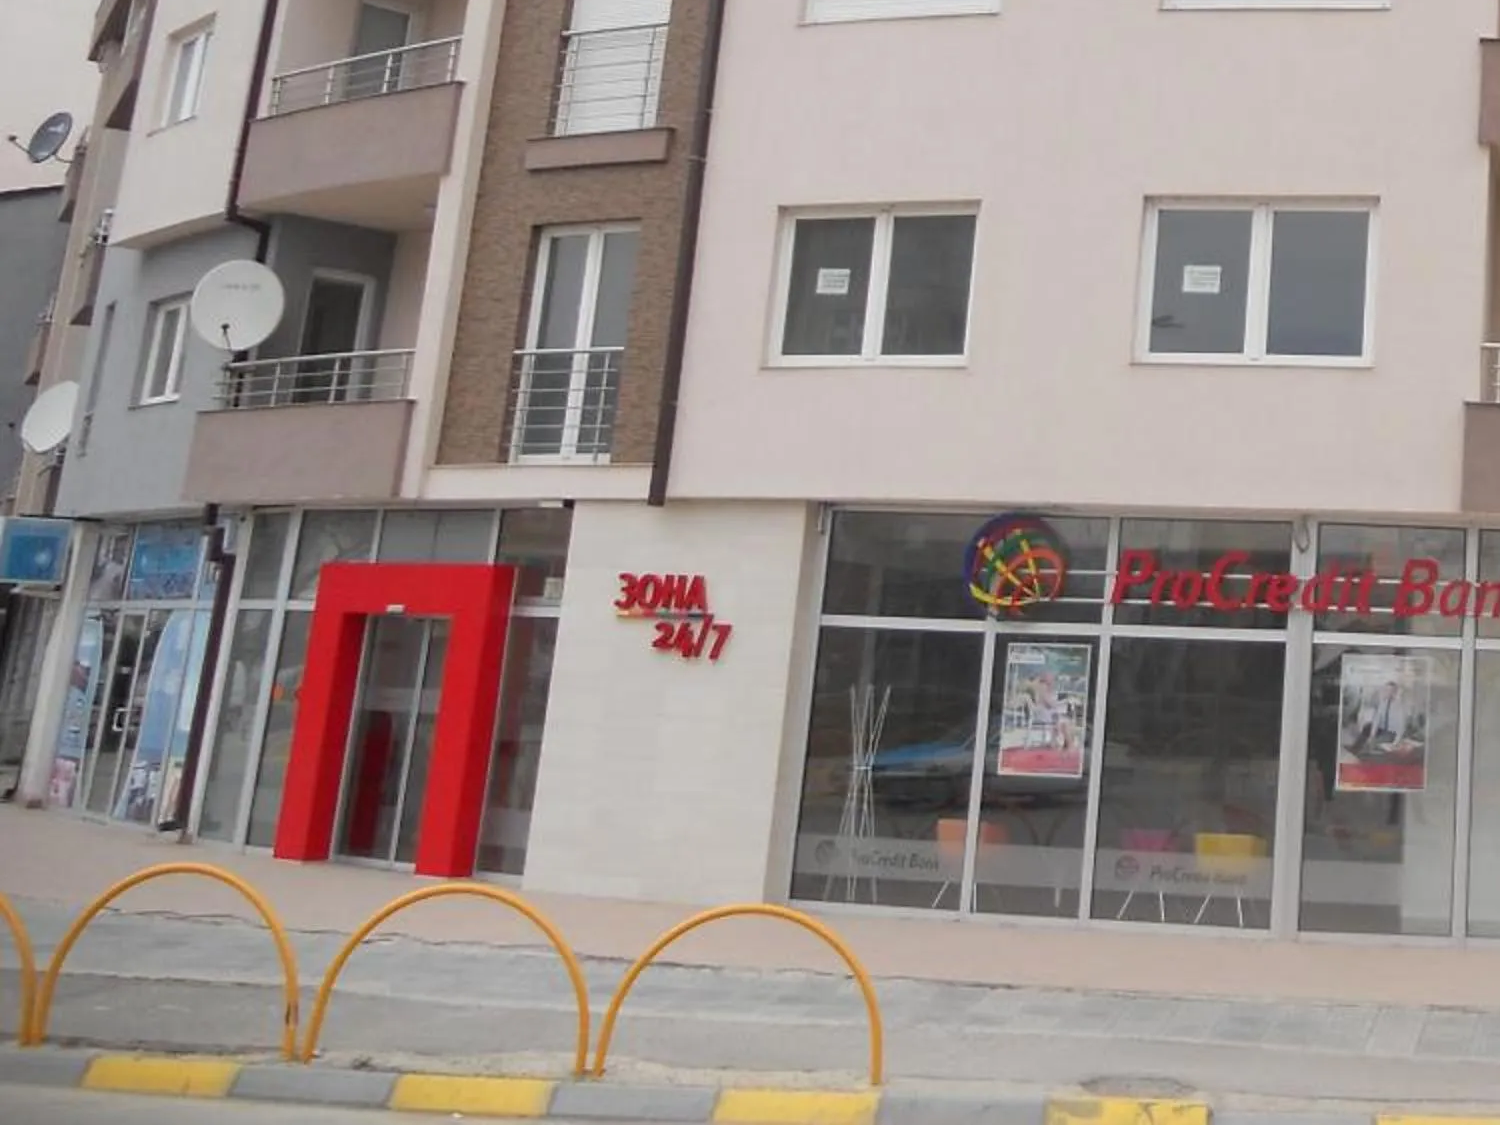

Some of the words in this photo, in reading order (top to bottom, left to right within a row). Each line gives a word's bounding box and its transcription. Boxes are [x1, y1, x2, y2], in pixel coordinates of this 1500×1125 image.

[613, 572, 707, 610] ЗОНА
[1110, 549, 1376, 617] ProCredit
[652, 613, 733, 660] 24/7
